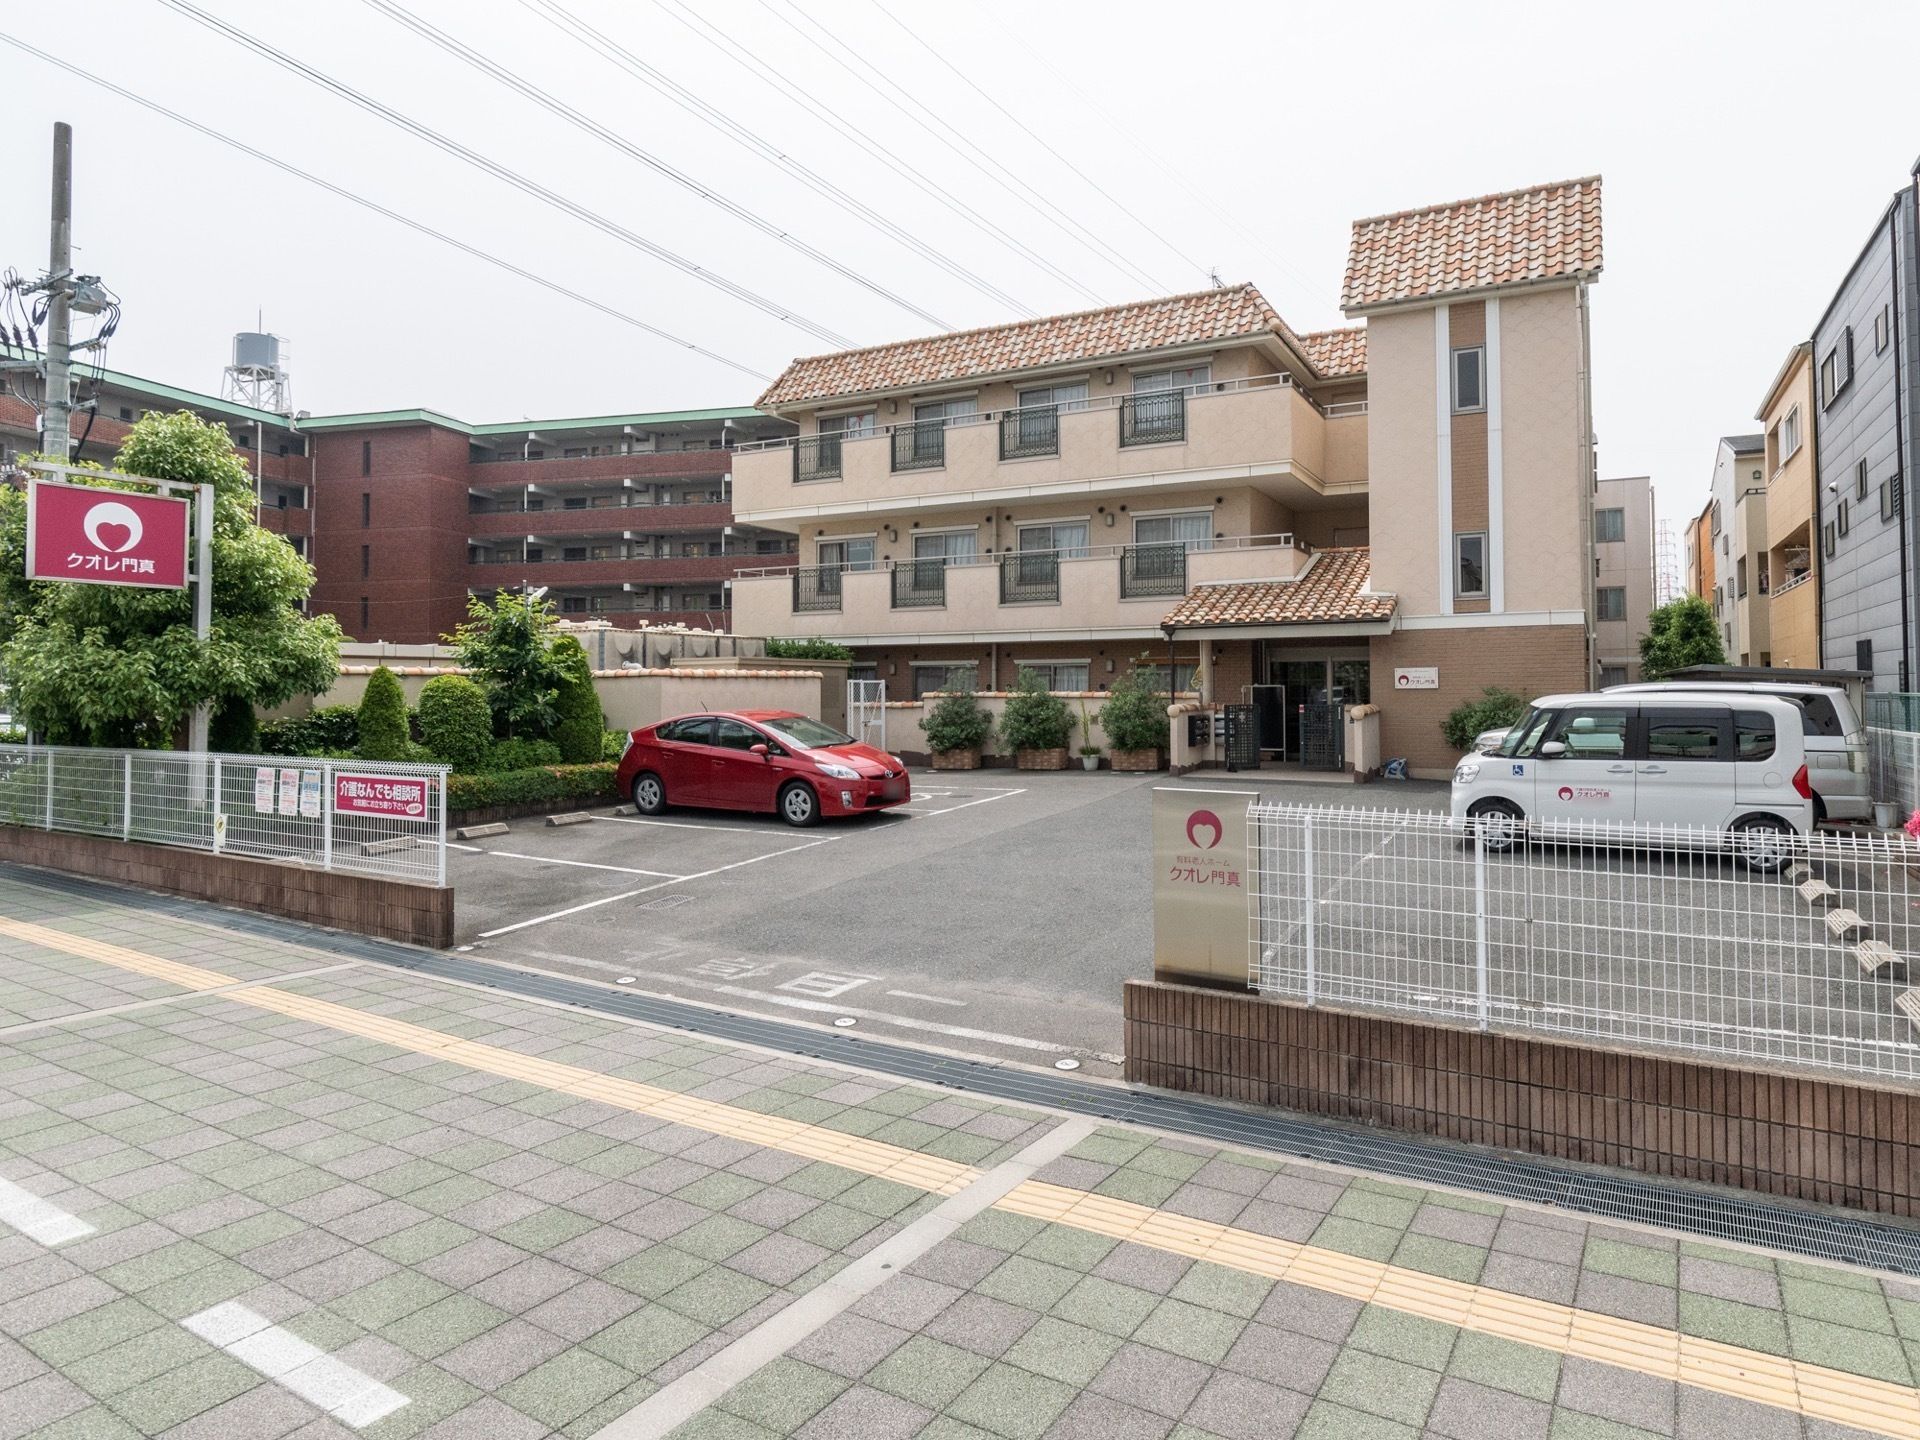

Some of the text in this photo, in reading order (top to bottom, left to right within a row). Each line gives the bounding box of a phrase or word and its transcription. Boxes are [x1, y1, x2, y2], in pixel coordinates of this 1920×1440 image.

[67, 552, 155, 574] クオレ門真
[340, 780, 421, 802] 介護なんでも相談所
[1169, 865, 1241, 887] クオレ門真
